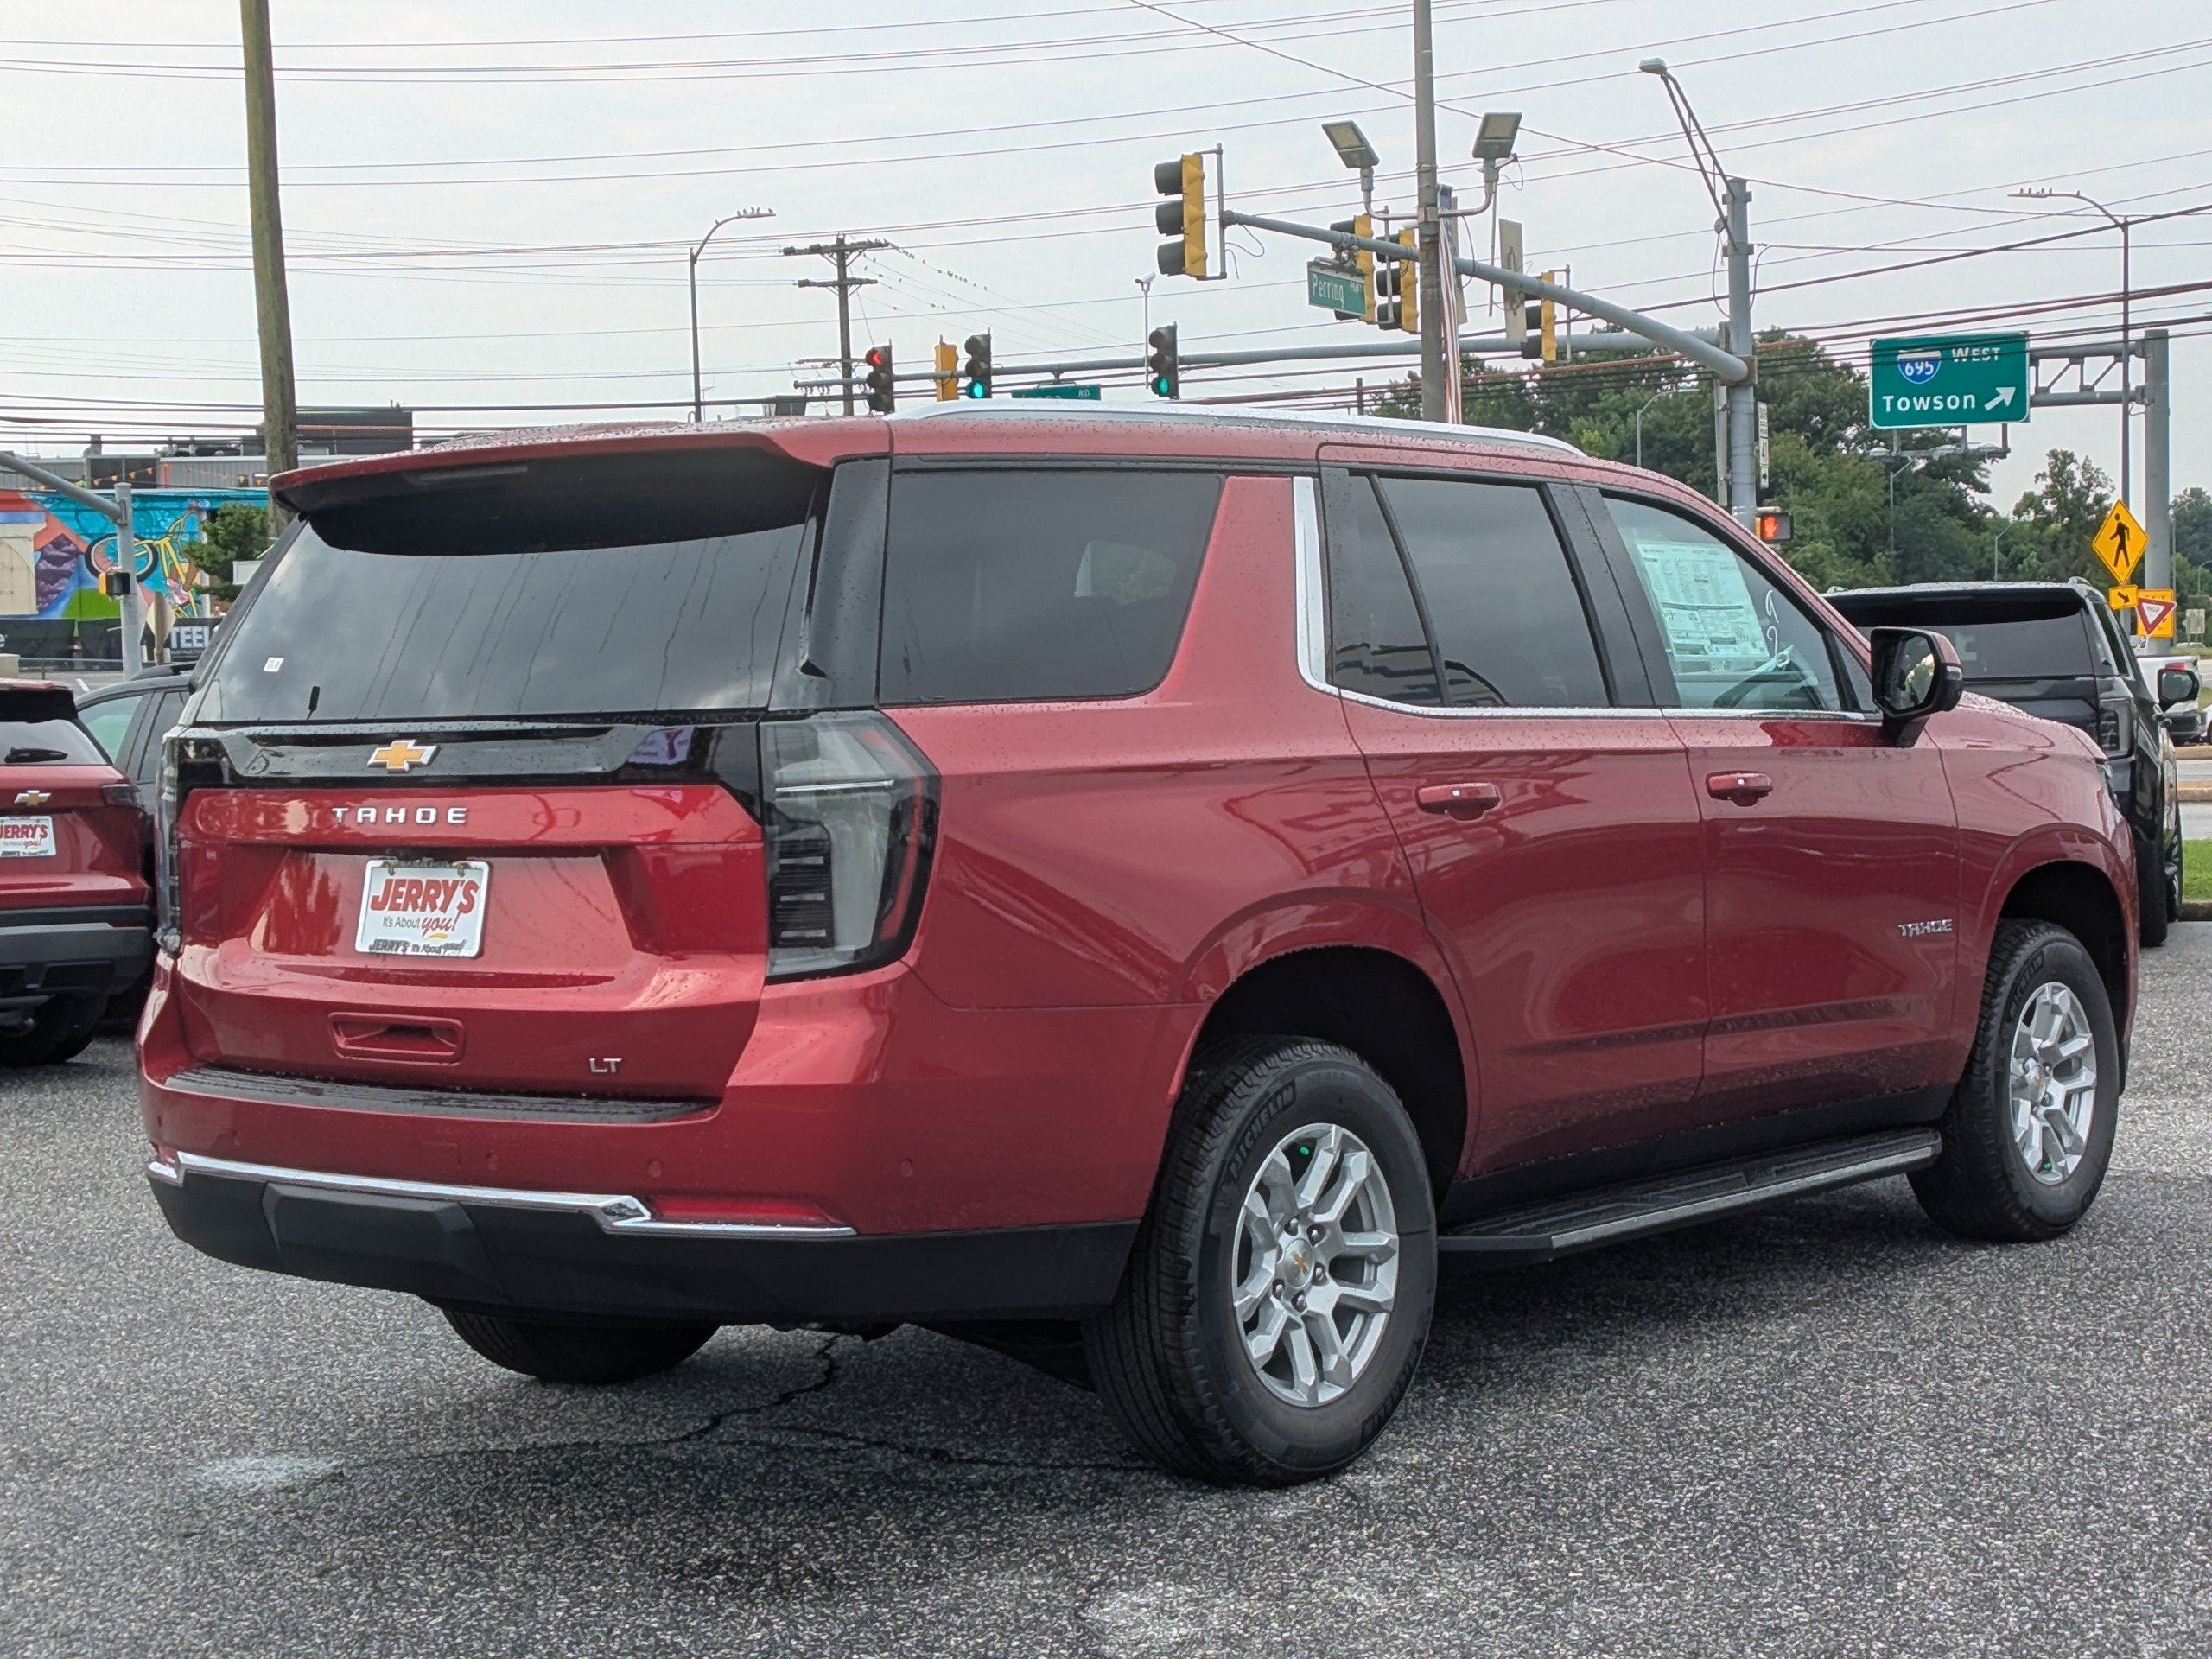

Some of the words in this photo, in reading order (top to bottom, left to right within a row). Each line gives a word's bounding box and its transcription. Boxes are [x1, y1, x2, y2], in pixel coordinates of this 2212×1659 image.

[1312, 272, 1344, 309] Perring
[1951, 347, 2001, 363] WEST
[1904, 361, 1935, 377] 695
[1077, 389, 1090, 397] RD
[1882, 394, 1976, 413] Towson
[331, 807, 468, 823] TAHOE
[370, 878, 480, 914] JERRY'S
[383, 917, 393, 928] It's
[395, 916, 420, 929] About
[421, 910, 461, 938] you!
[1898, 918, 1953, 938] TAHOE
[368, 938, 410, 953] JERRY'S
[588, 1058, 623, 1073] LT
